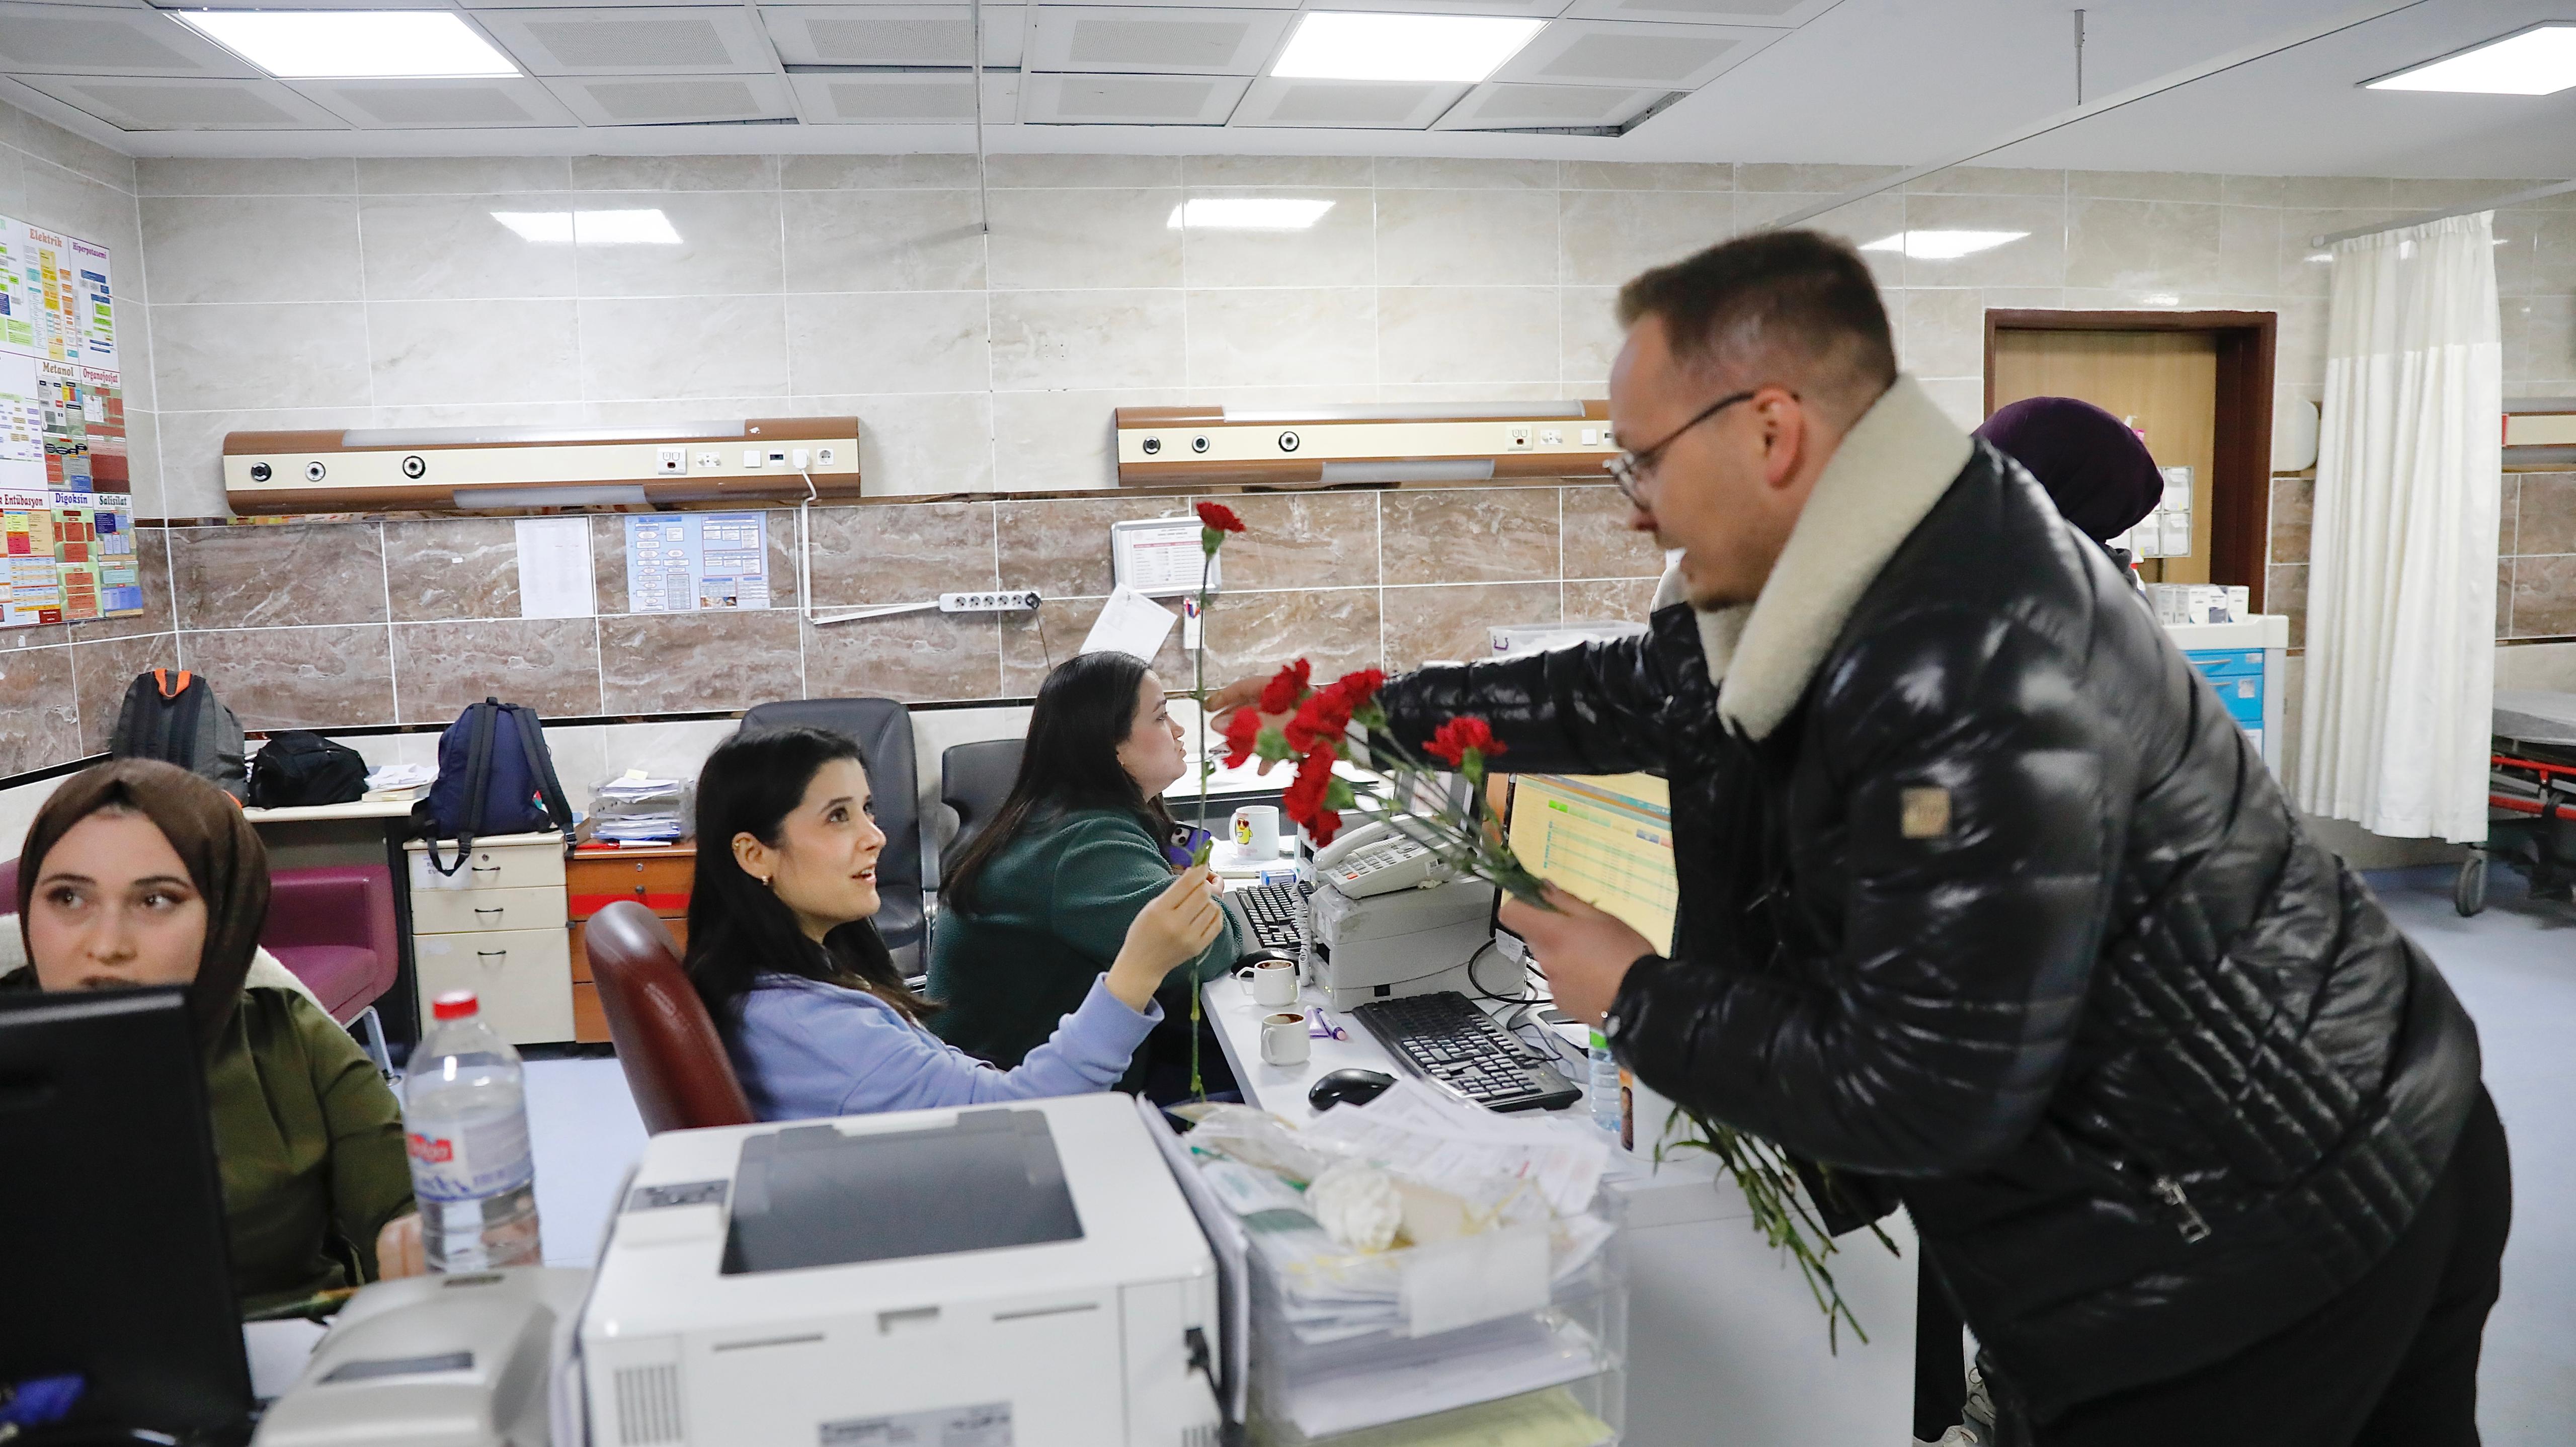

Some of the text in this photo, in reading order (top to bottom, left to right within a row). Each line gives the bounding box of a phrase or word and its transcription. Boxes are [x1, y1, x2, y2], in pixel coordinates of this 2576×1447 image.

[29, 228, 62, 248] Elektrik
[43, 362, 74, 376] Metanol
[5, 494, 43, 508] Entübasyon
[55, 493, 88, 506] Digoksin
[100, 495, 127, 506] Salisilat
